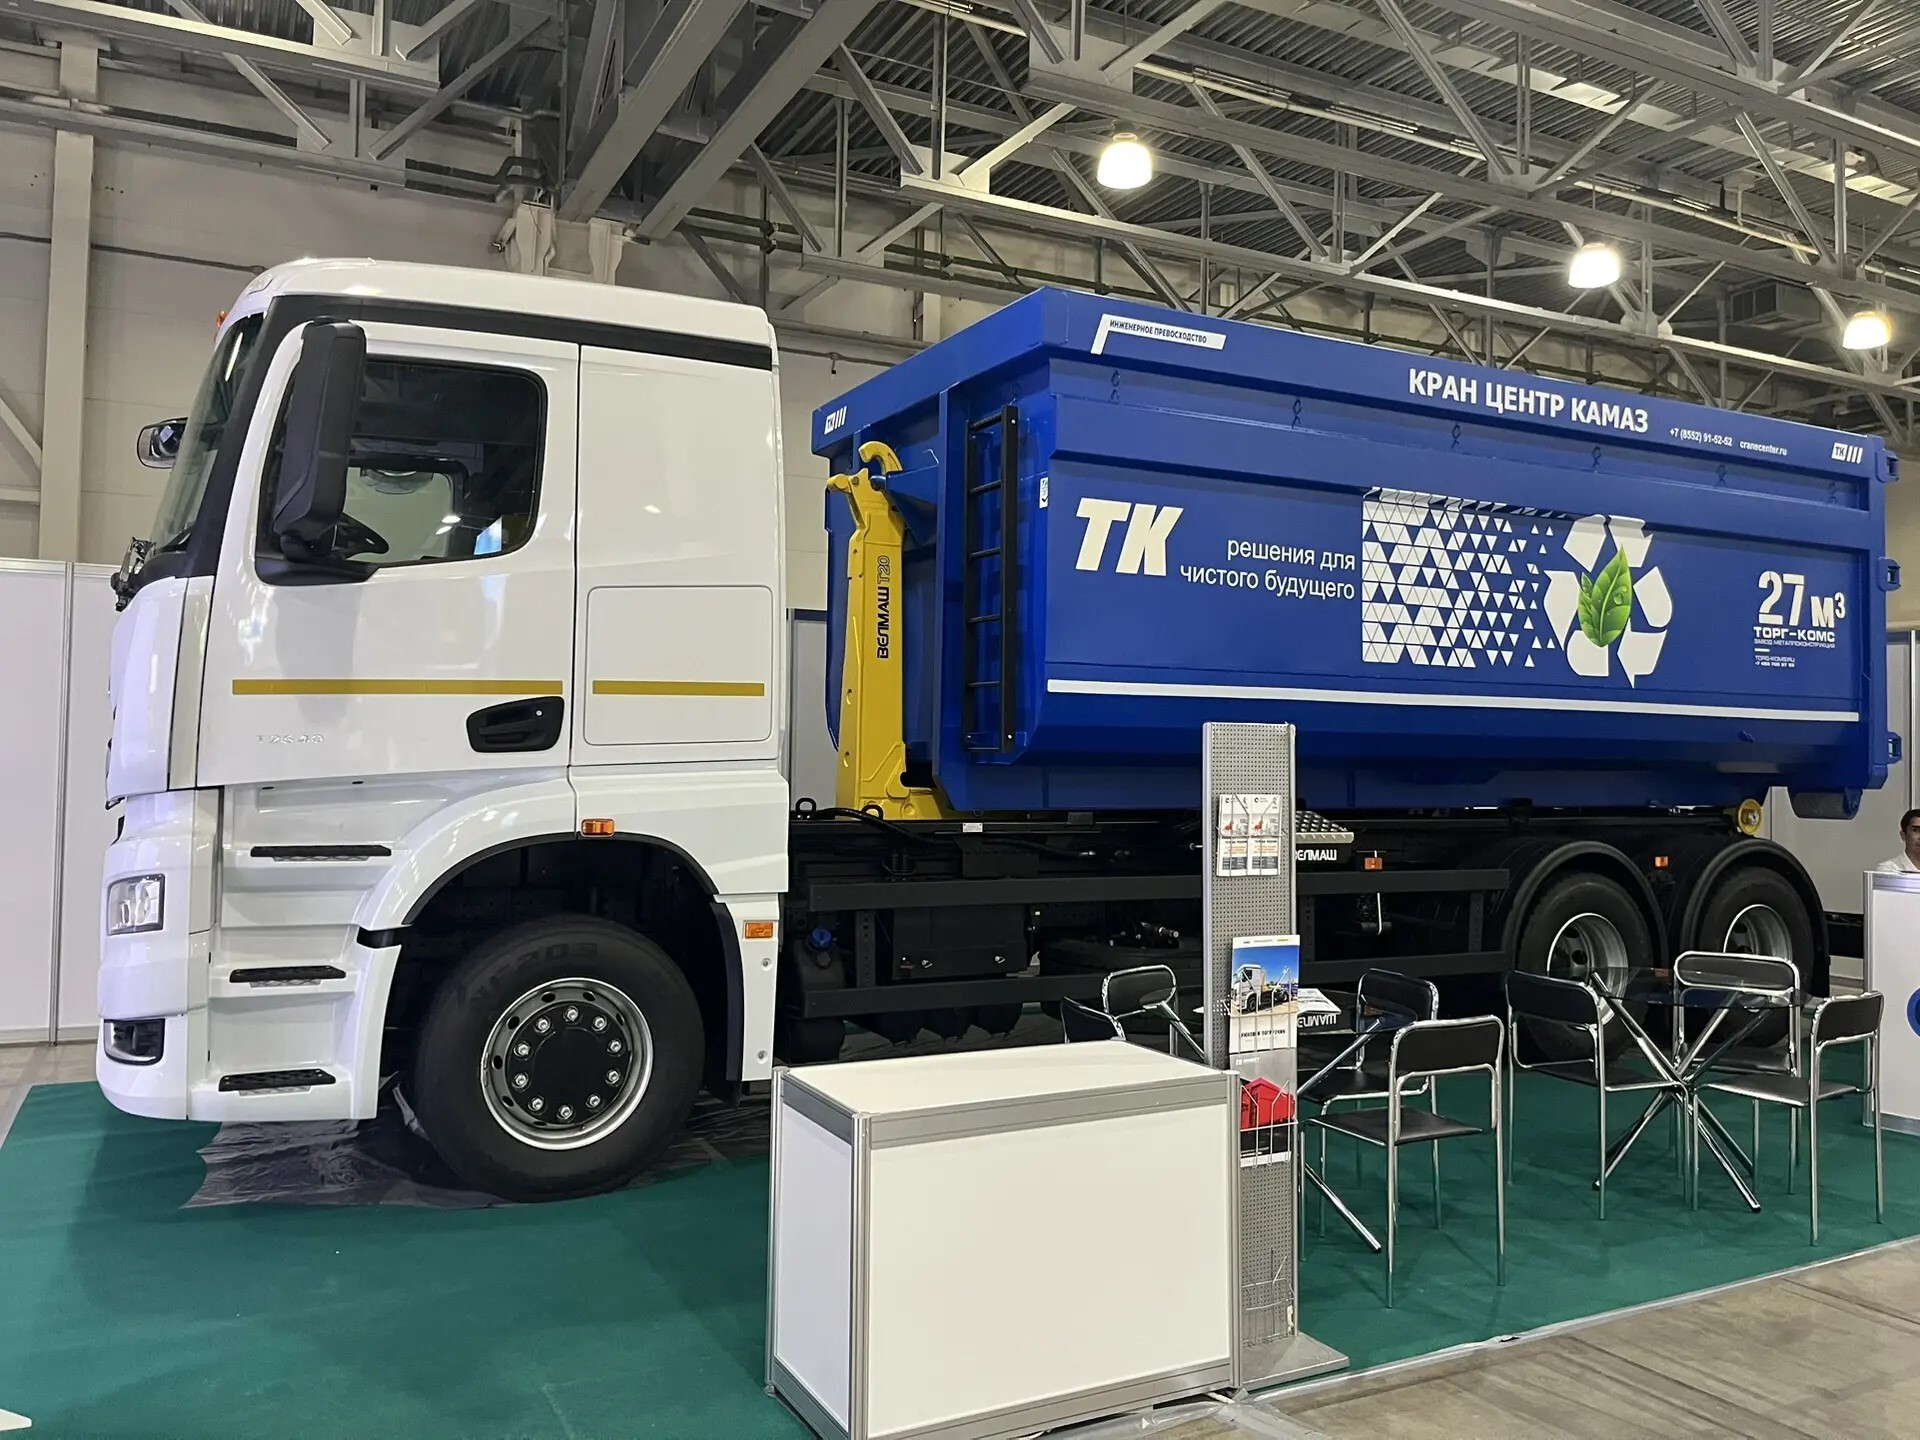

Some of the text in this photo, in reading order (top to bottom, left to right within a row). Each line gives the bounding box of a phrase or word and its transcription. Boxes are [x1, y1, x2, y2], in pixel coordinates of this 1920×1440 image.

[1109, 319, 1208, 344] ИНЖЕНЕРНОЕ ПРЕВОСХОДСТВО
[1409, 368, 1649, 433] КРАН ЦЕНТР КАМАЗ
[1669, 427, 1733, 447] +7 (8552) 91-52-52
[1739, 440, 1788, 456] cranecenter.ru
[1075, 497, 1184, 577] ТК
[1227, 538, 1355, 571] решения для
[1180, 563, 1355, 600] чистого будущего
[1758, 570, 1805, 626] 27
[876, 586, 890, 659] ВЕЛМАШ
[1753, 626, 1836, 643] ТОРГ-КОМС
